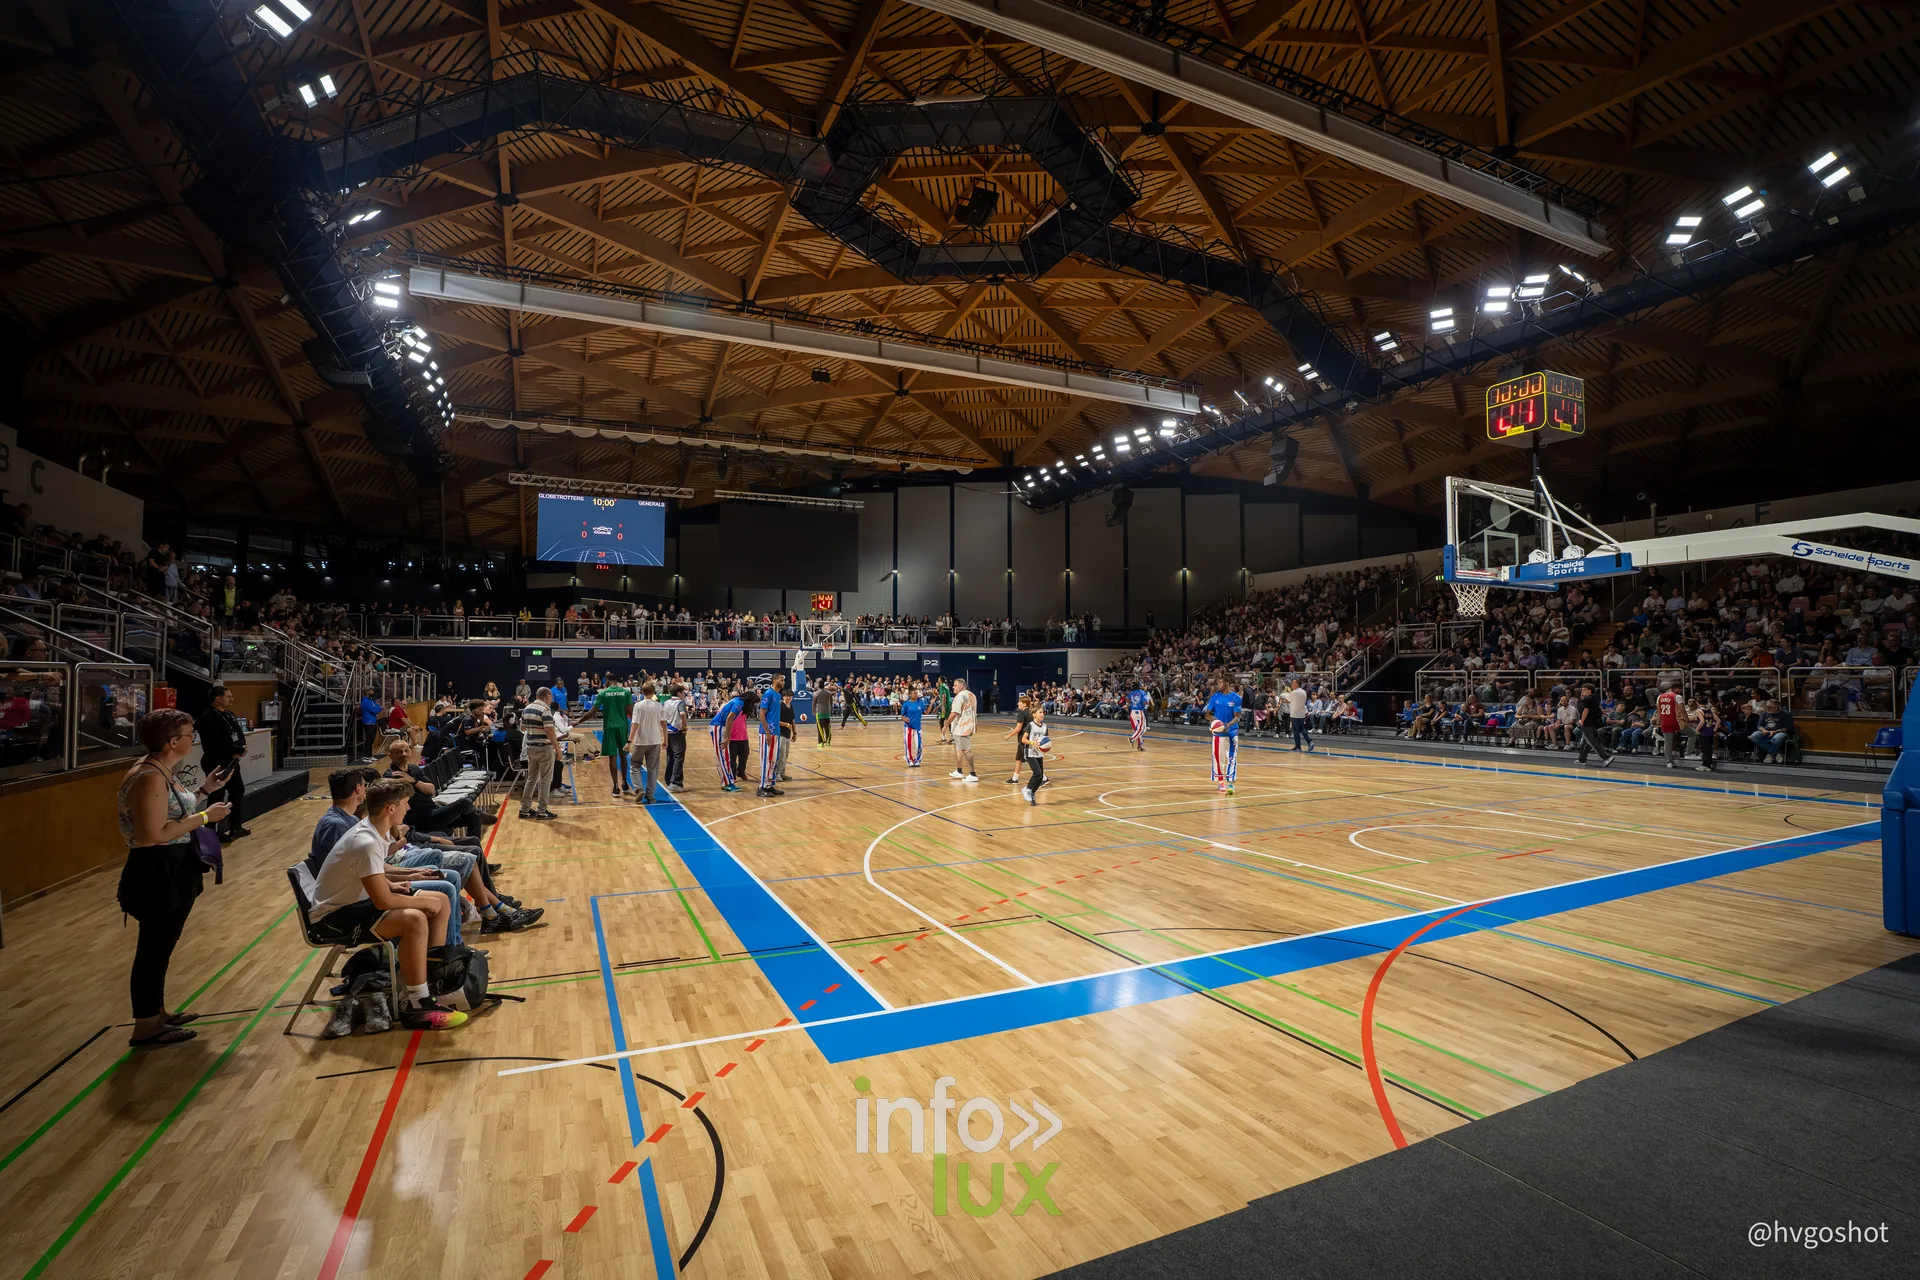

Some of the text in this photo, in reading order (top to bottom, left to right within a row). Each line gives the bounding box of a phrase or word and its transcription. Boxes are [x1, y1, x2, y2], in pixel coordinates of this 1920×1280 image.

[31, 460, 45, 495] C
[538, 493, 584, 501] GLOBETROTTERS
[593, 498, 615, 507] 10:00
[1815, 547, 1911, 571] Schelde Sports
[1547, 560, 1585, 569] Schelde
[1547, 566, 1585, 576] Sports
[1660, 704, 1671, 715] 23
[182, 778, 197, 788] OQUE
